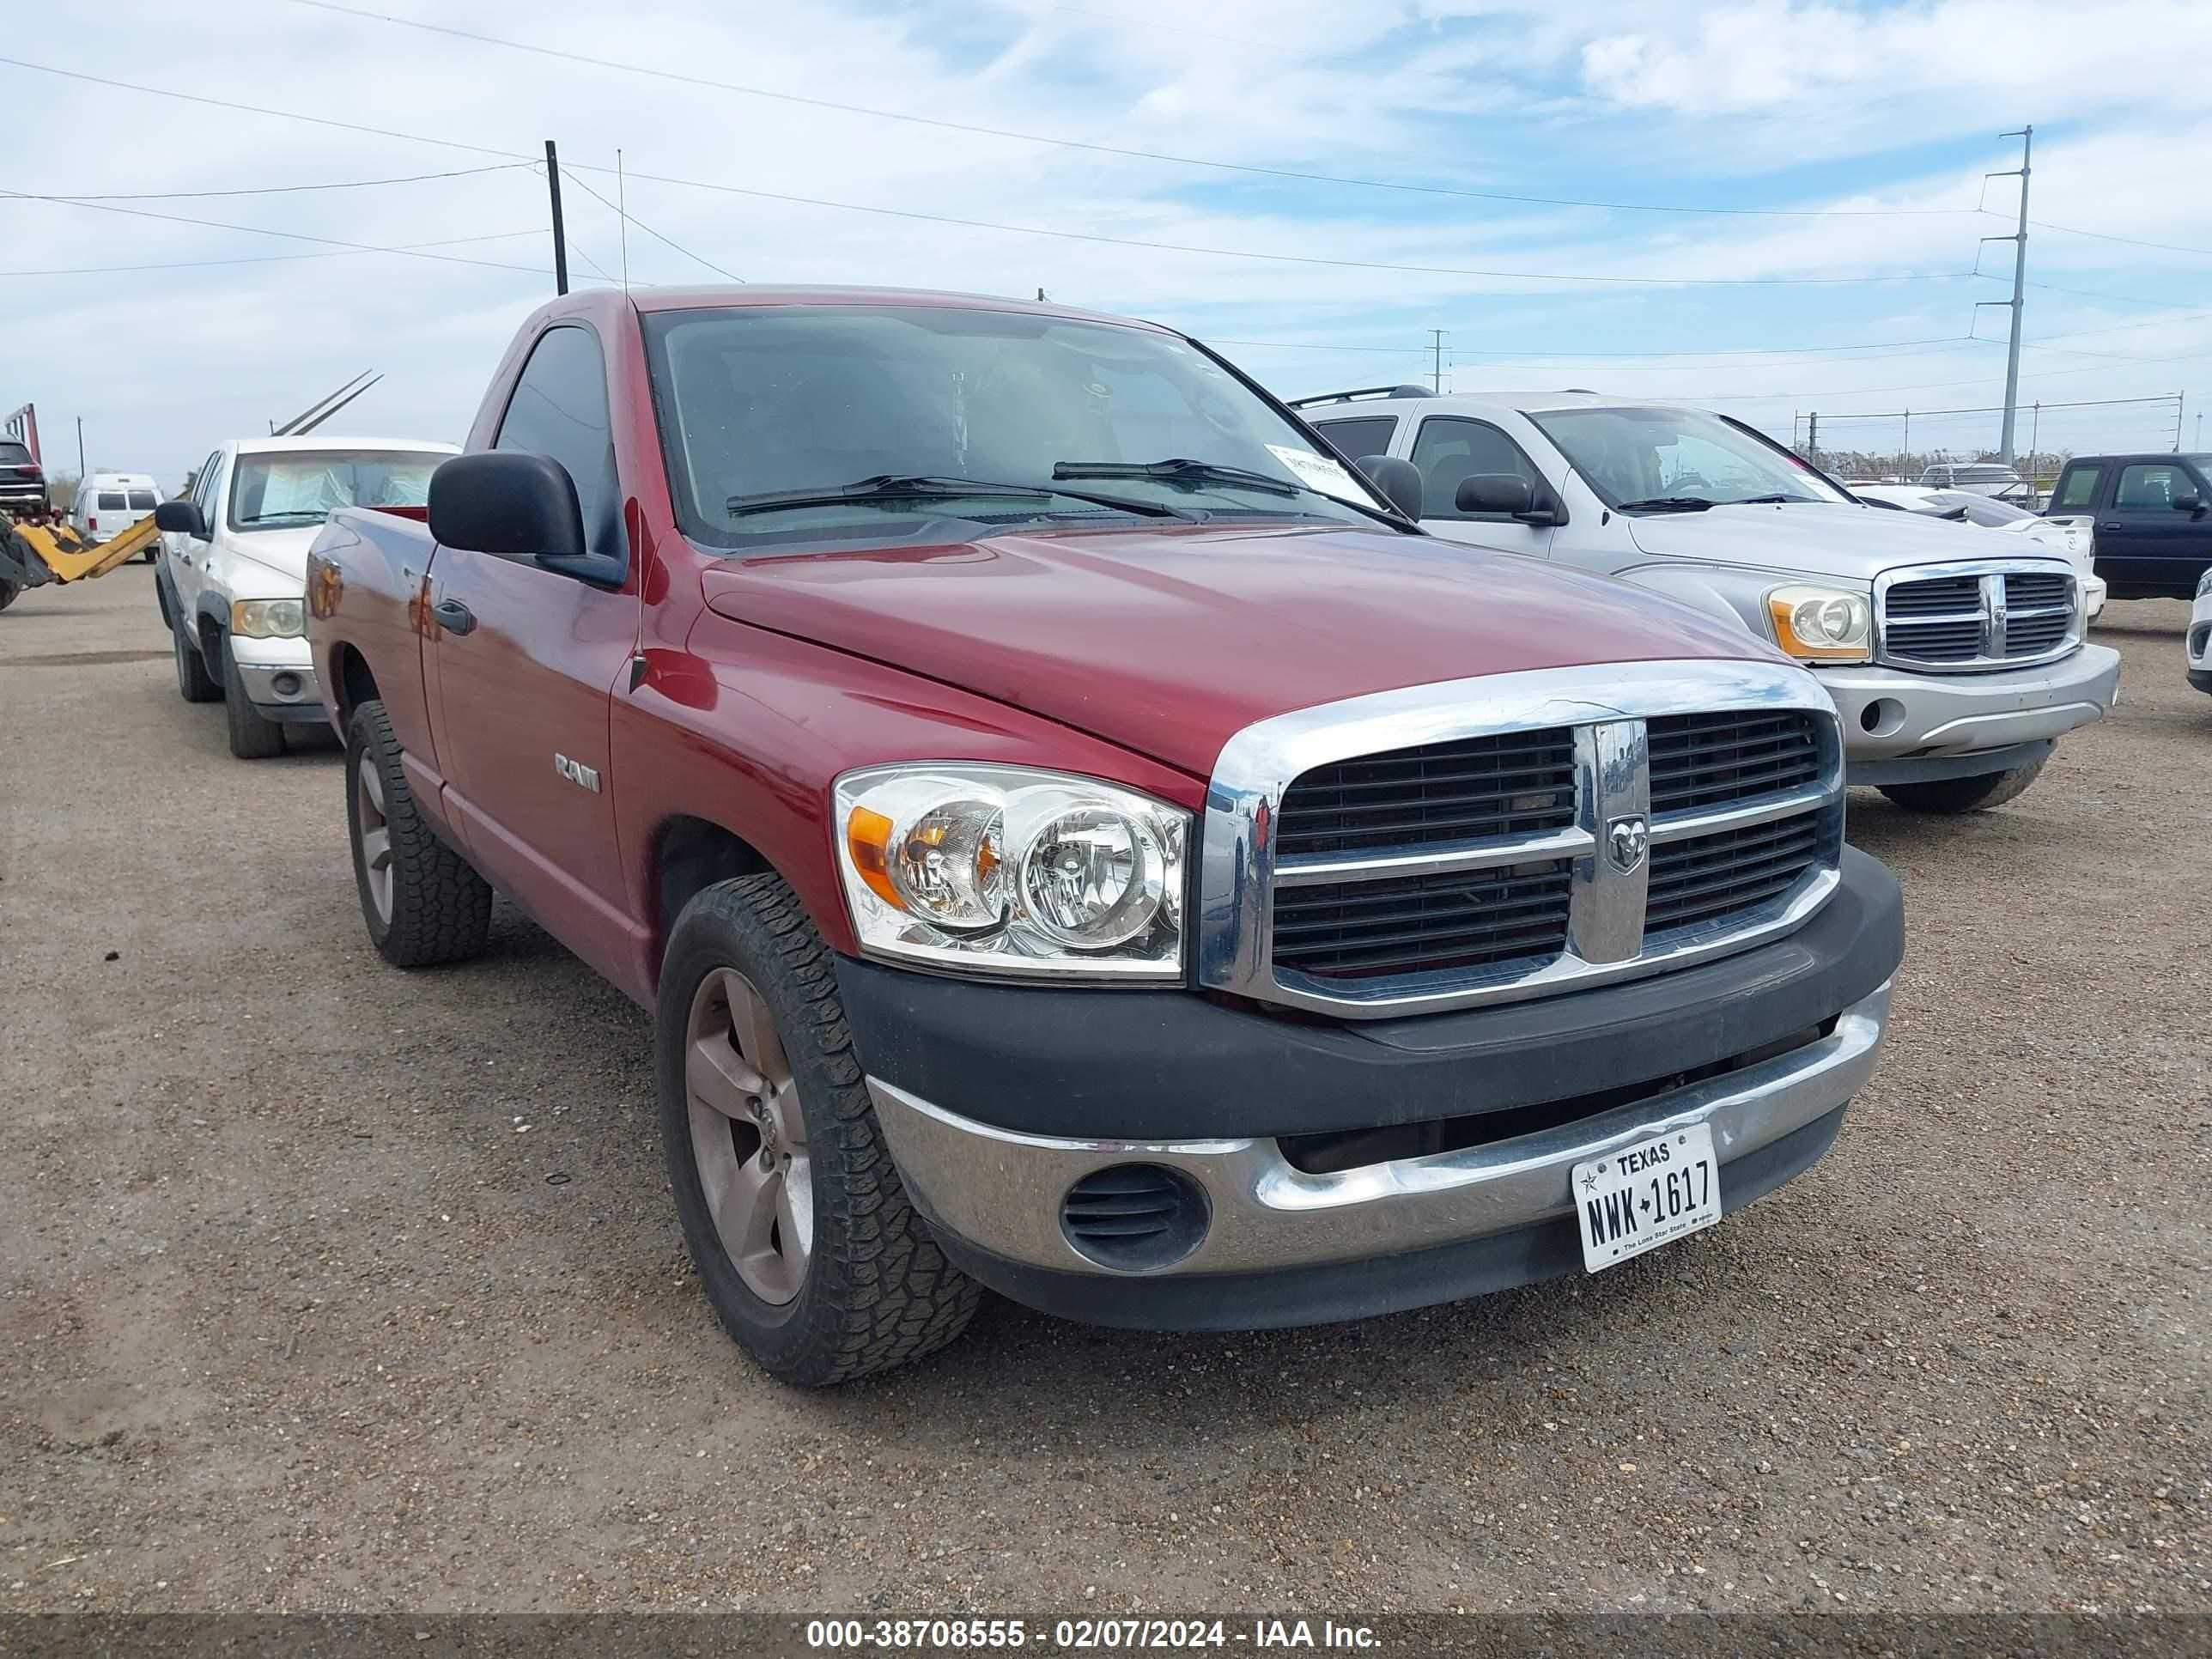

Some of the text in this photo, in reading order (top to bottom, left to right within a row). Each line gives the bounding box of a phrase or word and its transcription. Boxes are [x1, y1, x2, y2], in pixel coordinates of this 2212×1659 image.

[554, 752, 600, 793] RAM
[1616, 1142, 1670, 1176] TEXAS
[1586, 1159, 1708, 1248] NWK 1617
[1623, 1223, 1686, 1251] The Lone Star State
